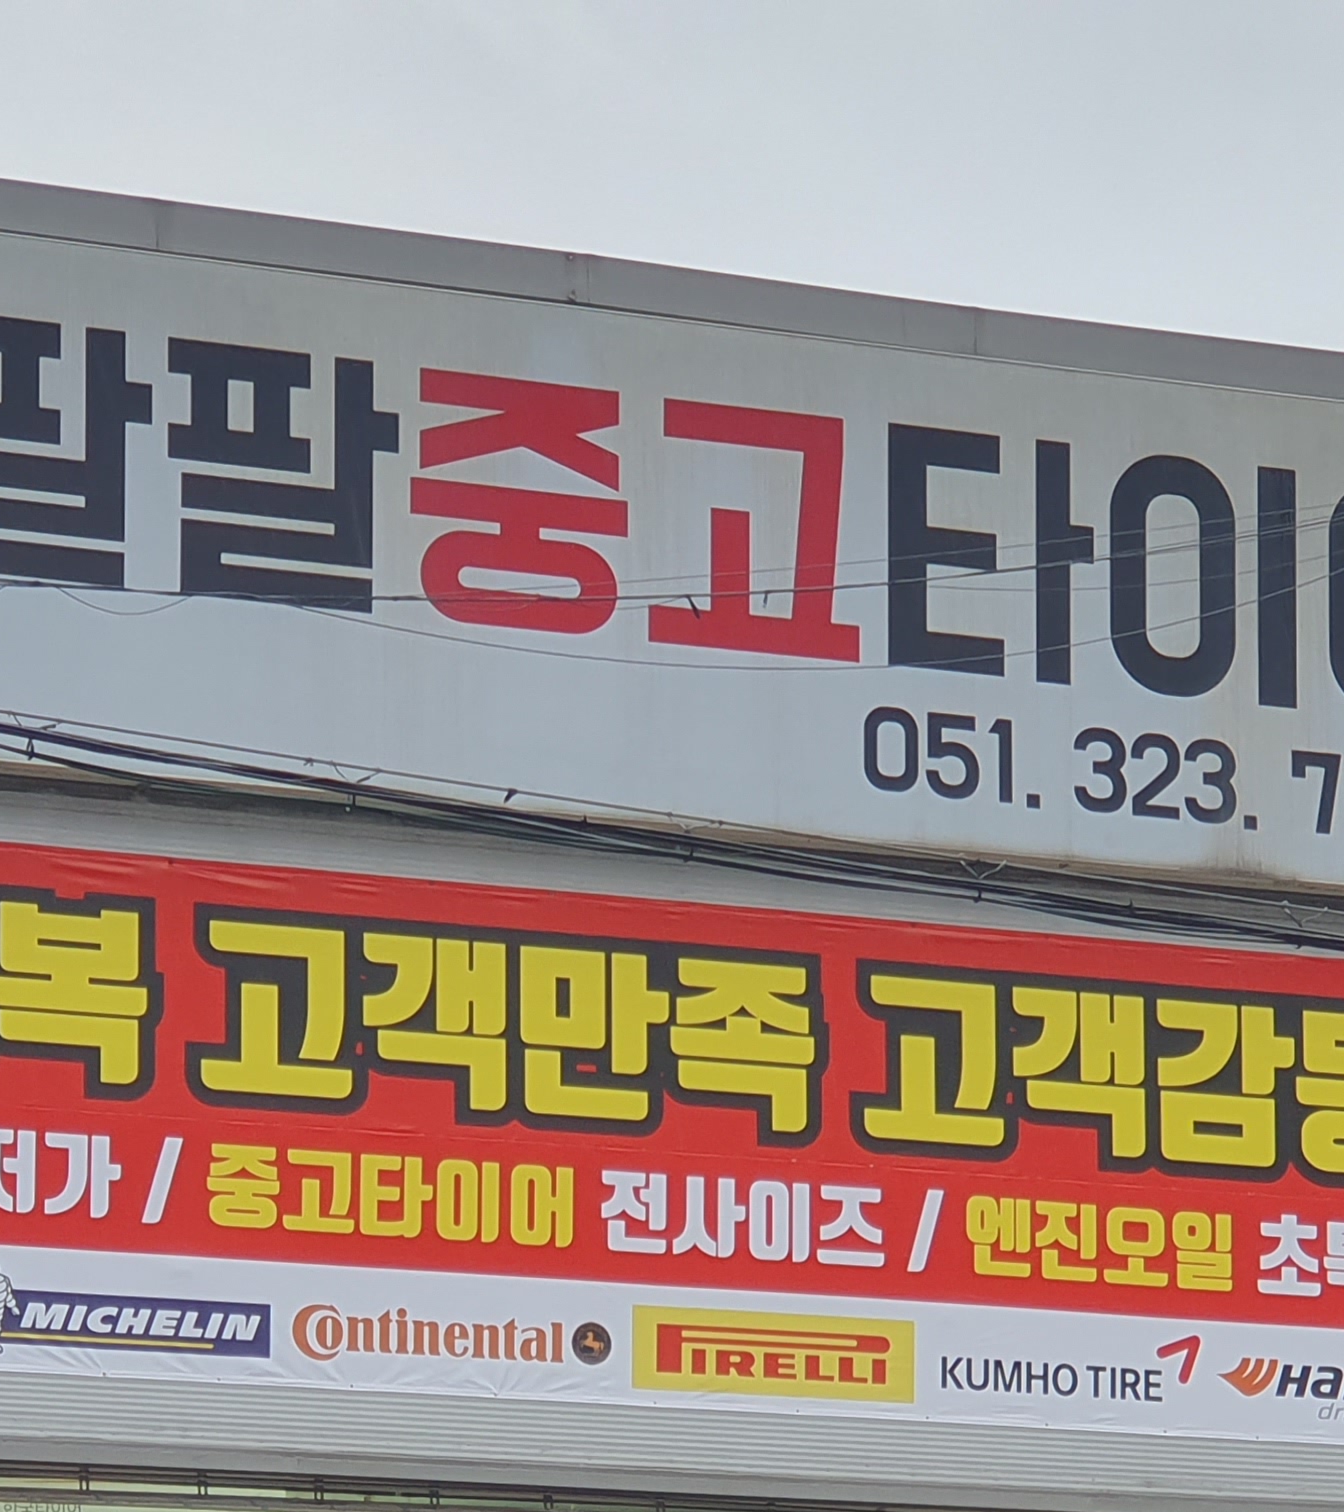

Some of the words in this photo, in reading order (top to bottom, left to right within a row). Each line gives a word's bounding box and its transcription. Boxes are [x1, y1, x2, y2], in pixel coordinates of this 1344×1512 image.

[195, 914, 820, 1138] 고객만족
[141, 1135, 184, 1225] /
[206, 1143, 574, 1248] 중고타이어
[600, 1169, 885, 1269] 전사이즈
[906, 1188, 944, 1273] /
[965, 1194, 1233, 1292] 엔진오일
[18, 1299, 262, 1341] MICHELIN
[291, 1303, 565, 1363] Continental
[656, 1323, 891, 1386] PIRELLI
[940, 1355, 1080, 1399] KUMHO
[1085, 1364, 1164, 1403] TIRE
